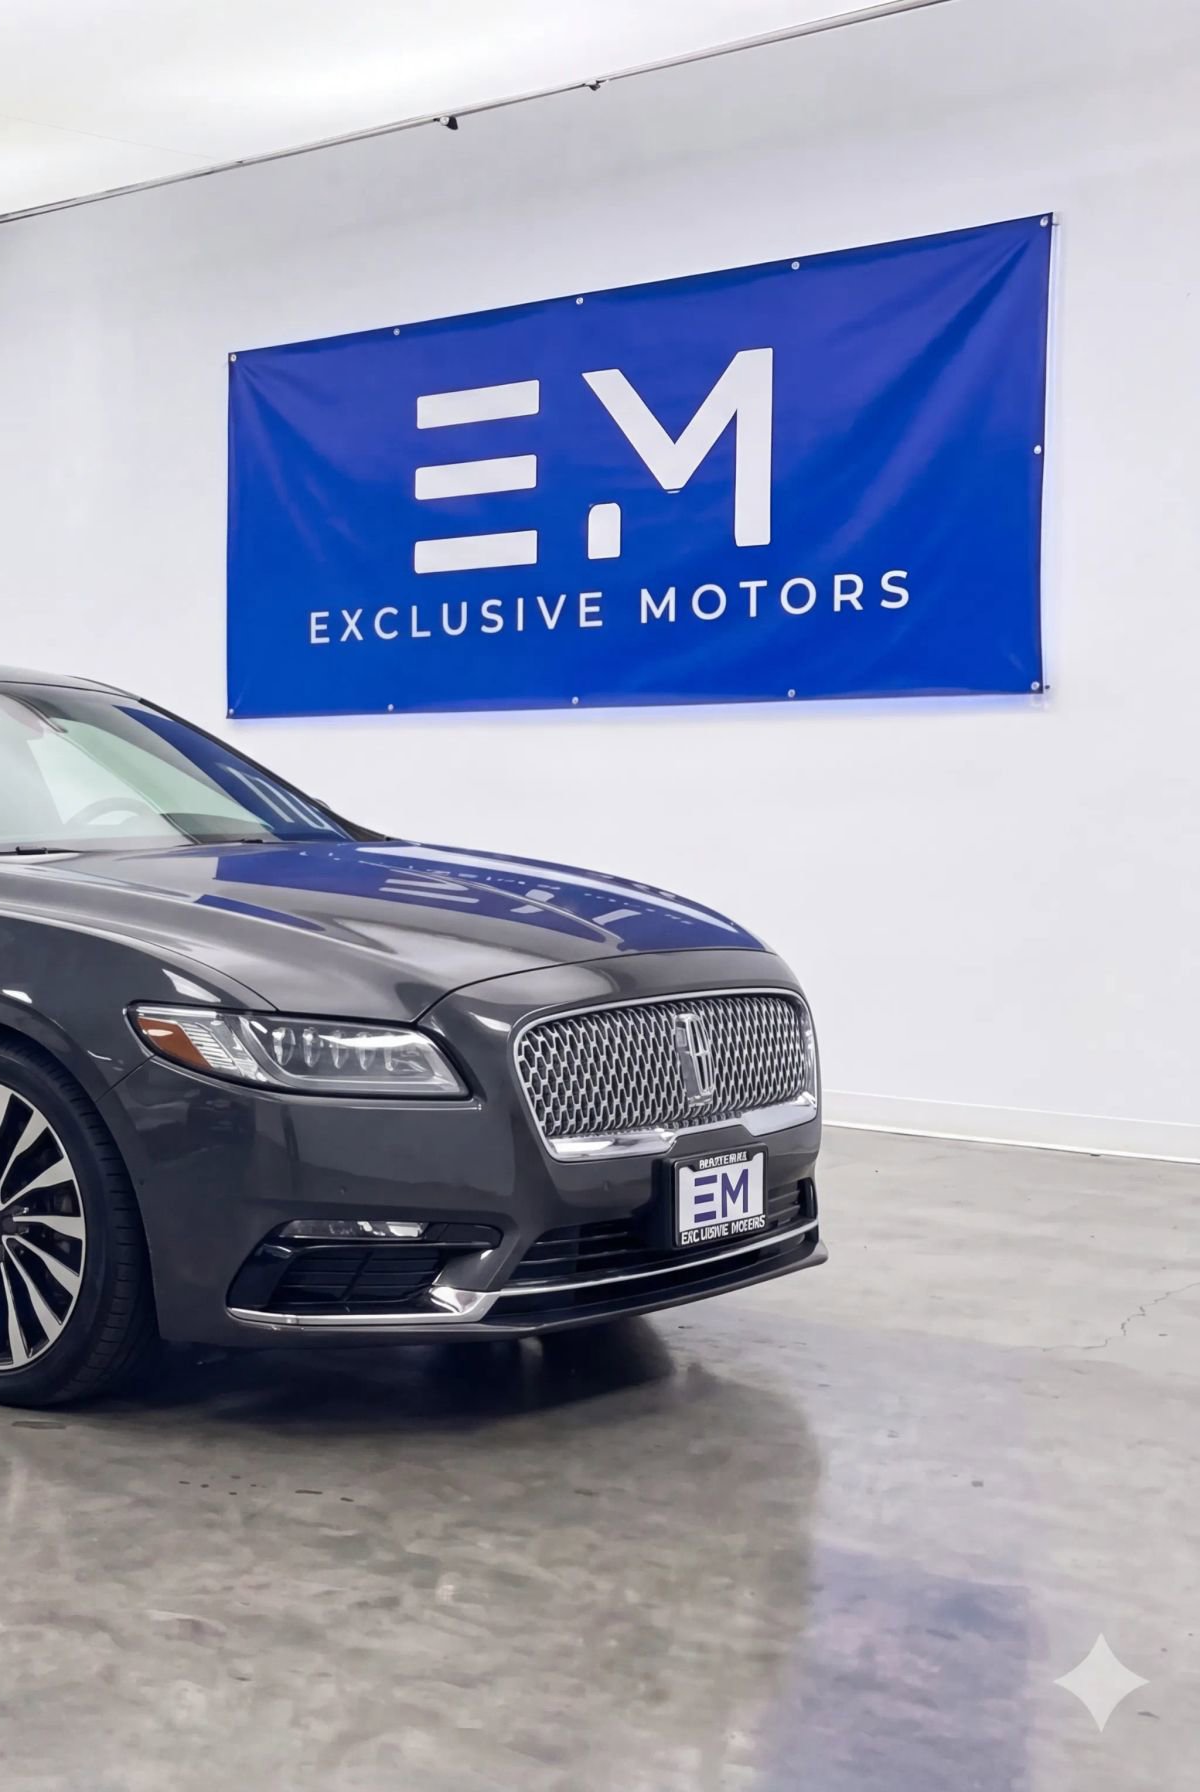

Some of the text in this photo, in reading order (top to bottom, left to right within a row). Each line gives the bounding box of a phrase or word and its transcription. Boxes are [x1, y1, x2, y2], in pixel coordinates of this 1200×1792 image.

[413, 347, 774, 575] EM
[310, 570, 909, 644] EXCLUSIVE MOTORS
[694, 1168, 749, 1223] EM
